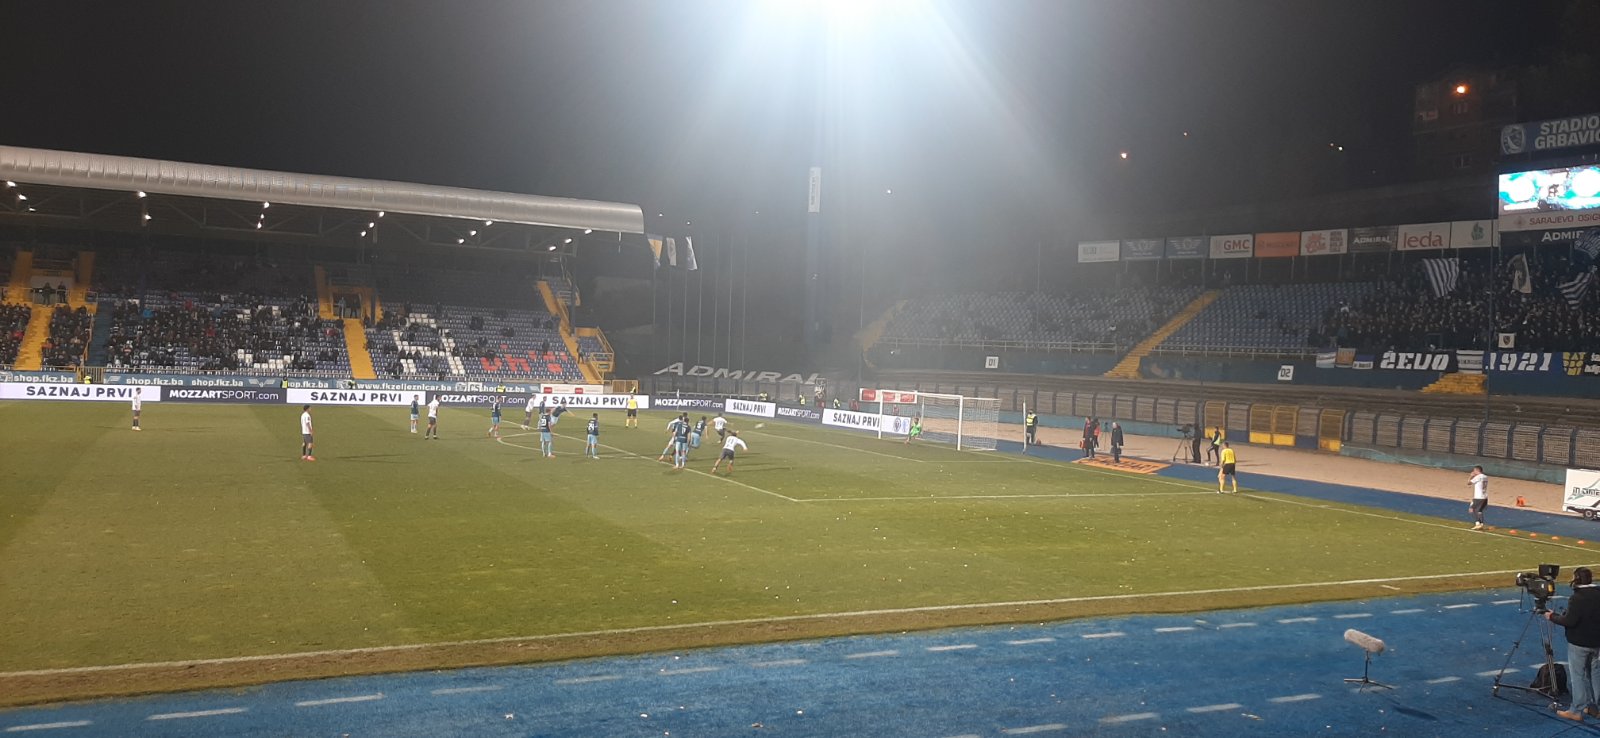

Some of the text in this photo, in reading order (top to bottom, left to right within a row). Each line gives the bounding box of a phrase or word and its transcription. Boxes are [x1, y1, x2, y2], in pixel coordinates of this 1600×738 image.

[1529, 214, 1574, 226] SARAJEVO
[1223, 239, 1250, 251] GMC
[1353, 235, 1393, 245] ADMIRAL
[1403, 231, 1444, 249] leda
[1490, 352, 1552, 371] 1921
[14, 374, 74, 384] shop.fkz.ba
[653, 362, 819, 385] ADMIRAL
[1280, 368, 1291, 378] 02
[126, 377, 184, 387] shop.fkz.ba
[191, 378, 244, 388] shop.fkz.ba
[26, 386, 132, 398] SAZNAJ PRVI
[169, 388, 279, 400] MOZZARTSPORT.com
[310, 391, 402, 402] SAZNAJ PRVI
[552, 396, 599, 405] SAZNAJ
[654, 398, 724, 409] MOZZARTSPORT.com
[733, 401, 767, 413] SAZNAJ PRVI
[832, 412, 880, 428] SAZNAJ PRVI
